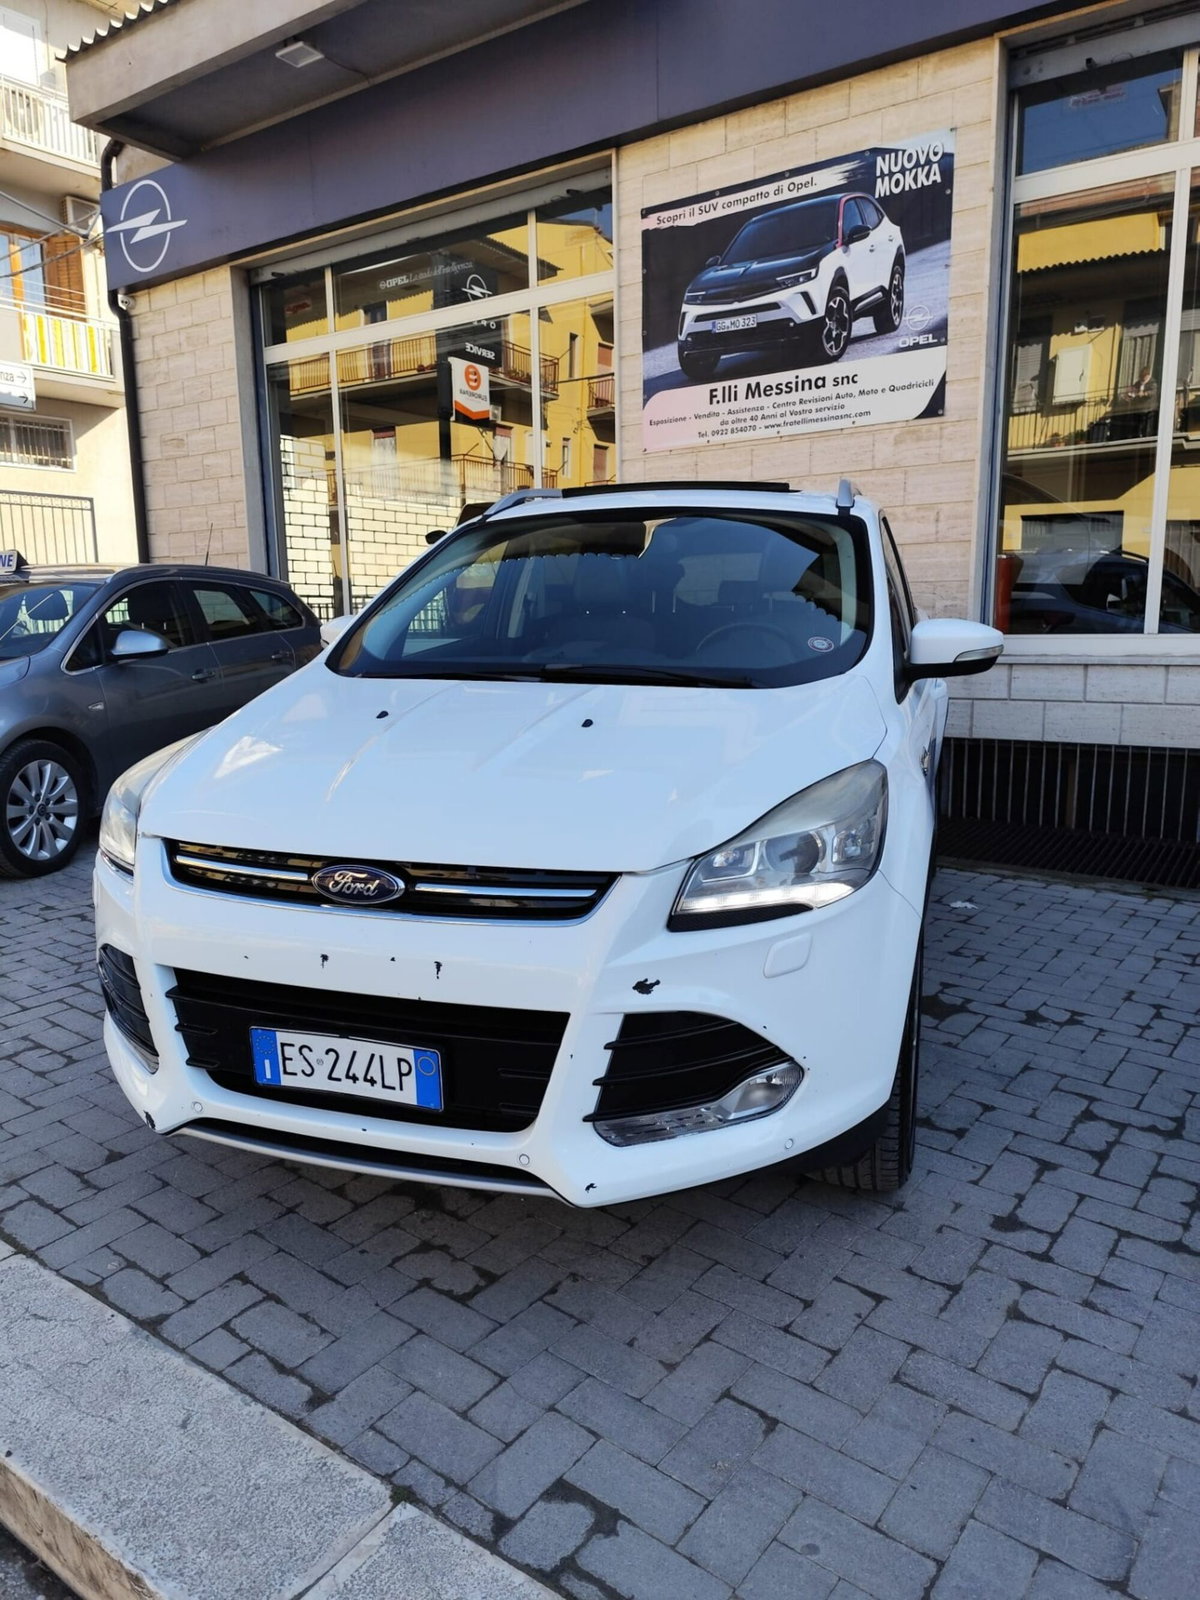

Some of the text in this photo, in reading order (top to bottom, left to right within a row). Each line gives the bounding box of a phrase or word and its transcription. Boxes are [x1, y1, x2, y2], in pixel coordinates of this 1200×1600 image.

[876, 140, 944, 177] NUOVO
[875, 163, 941, 198] MOKKA
[656, 177, 817, 226] Scopri il SUV compatto di Opel.
[386, 275, 409, 288] OPEL
[742, 316, 756, 327] 323
[899, 334, 938, 347] OPEL
[649, 415, 687, 426] Esposizione
[694, 411, 720, 420] Vendita
[727, 404, 764, 416] Assistenza
[772, 400, 796, 410] Centro
[799, 394, 833, 405] Revisioni
[835, 391, 856, 400] Auto,
[858, 388, 878, 397] Moto
[889, 378, 934, 392] Quadricicli
[709, 374, 858, 405] F.lli Messina snc
[711, 428, 728, 437] 0922
[730, 425, 757, 434] 854070
[764, 410, 871, 430] www.fratellimessinasnc.com
[720, 418, 729, 426] da
[731, 416, 748, 425] oltre
[761, 411, 778, 420] Anni
[780, 410, 787, 418] al
[789, 407, 813, 417] Vostro
[815, 403, 845, 413] servizio
[329, 870, 380, 896] Ford
[280, 1042, 315, 1078] ES
[325, 1048, 412, 1091] 244LP
